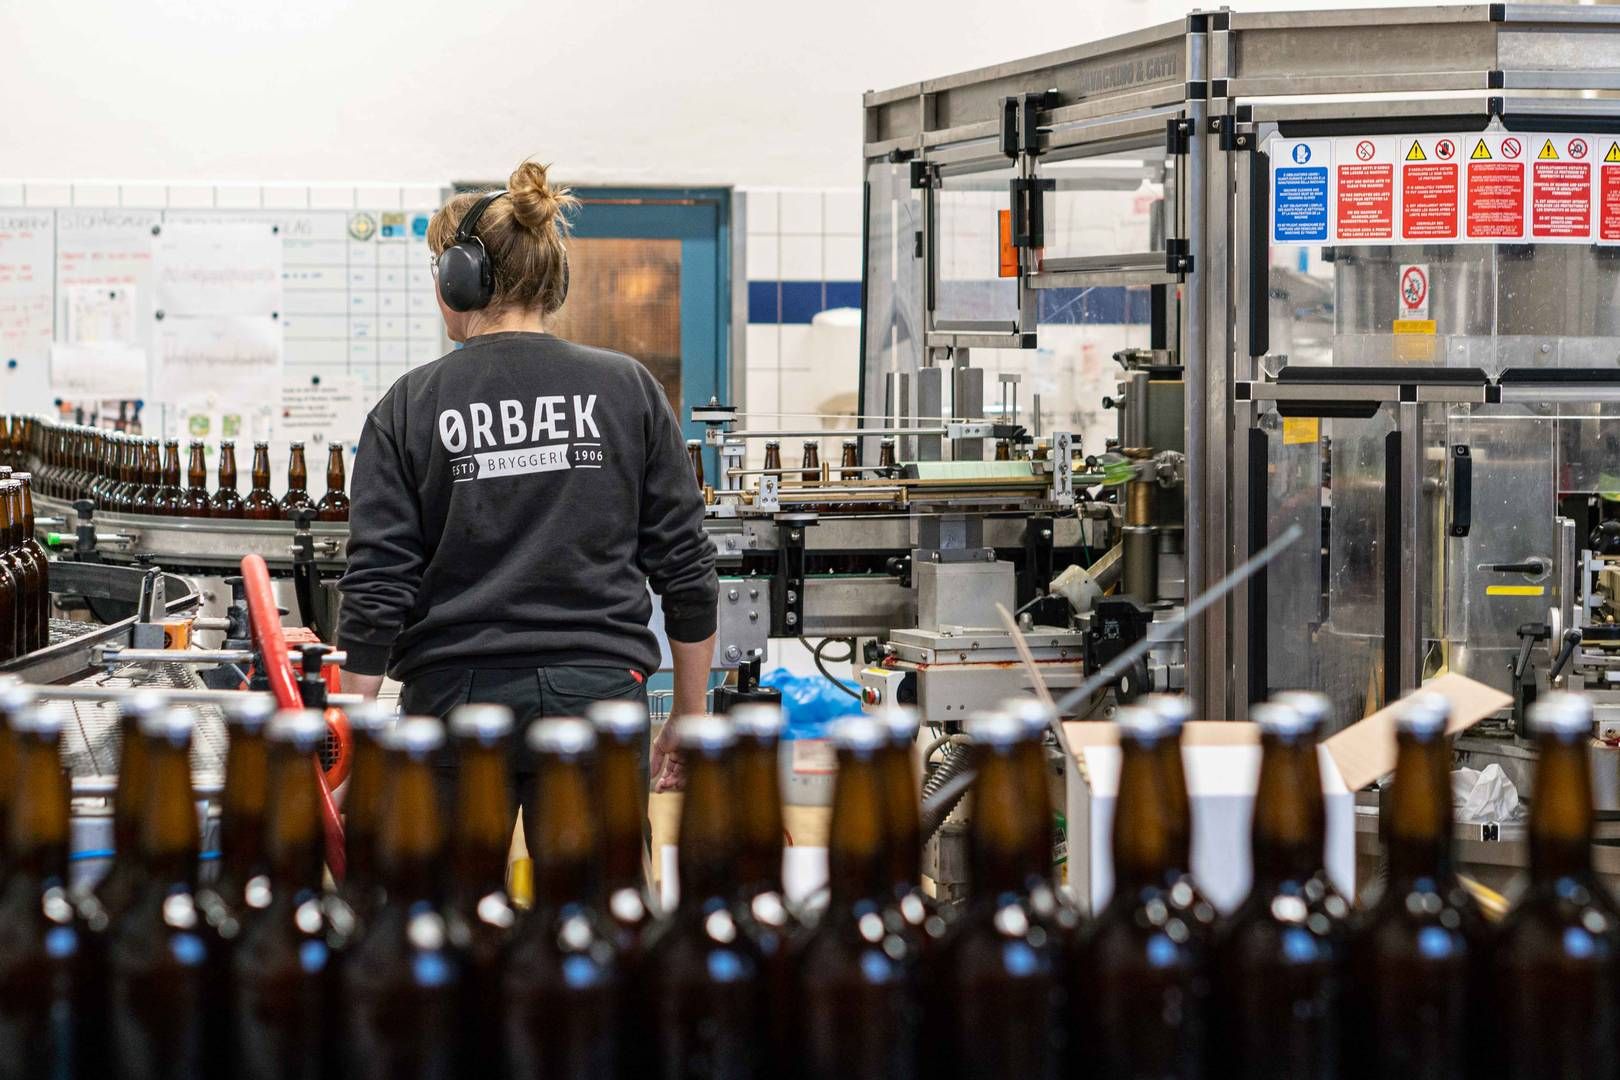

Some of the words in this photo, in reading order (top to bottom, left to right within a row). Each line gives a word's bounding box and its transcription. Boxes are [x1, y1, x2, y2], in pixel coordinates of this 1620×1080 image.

[438, 394, 601, 454] ØRBÆK
[452, 464, 475, 476] ESTD
[488, 452, 563, 471] BRYGGERI
[574, 450, 603, 462] 1906
